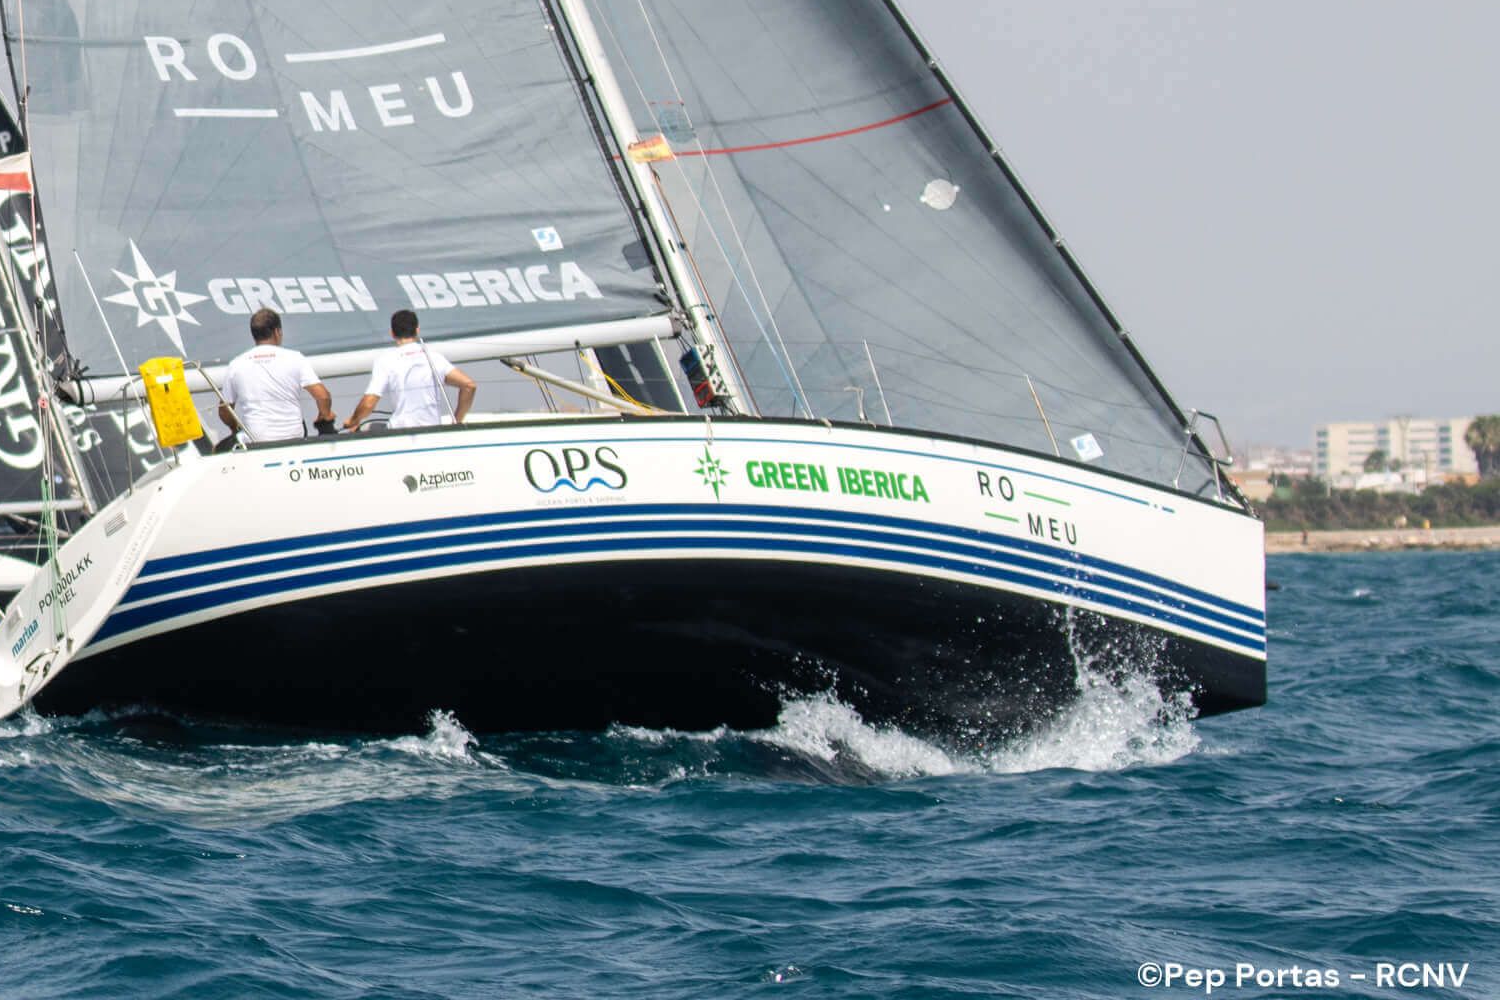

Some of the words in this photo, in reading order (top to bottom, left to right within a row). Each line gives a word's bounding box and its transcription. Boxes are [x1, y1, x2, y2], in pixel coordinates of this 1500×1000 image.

[207, 275, 378, 314] GREEN
[397, 262, 603, 309] IBERICA
[308, 465, 364, 481] Marylou
[524, 447, 627, 493] OPS
[746, 459, 828, 494] GREEN
[836, 466, 931, 503] IBERICA
